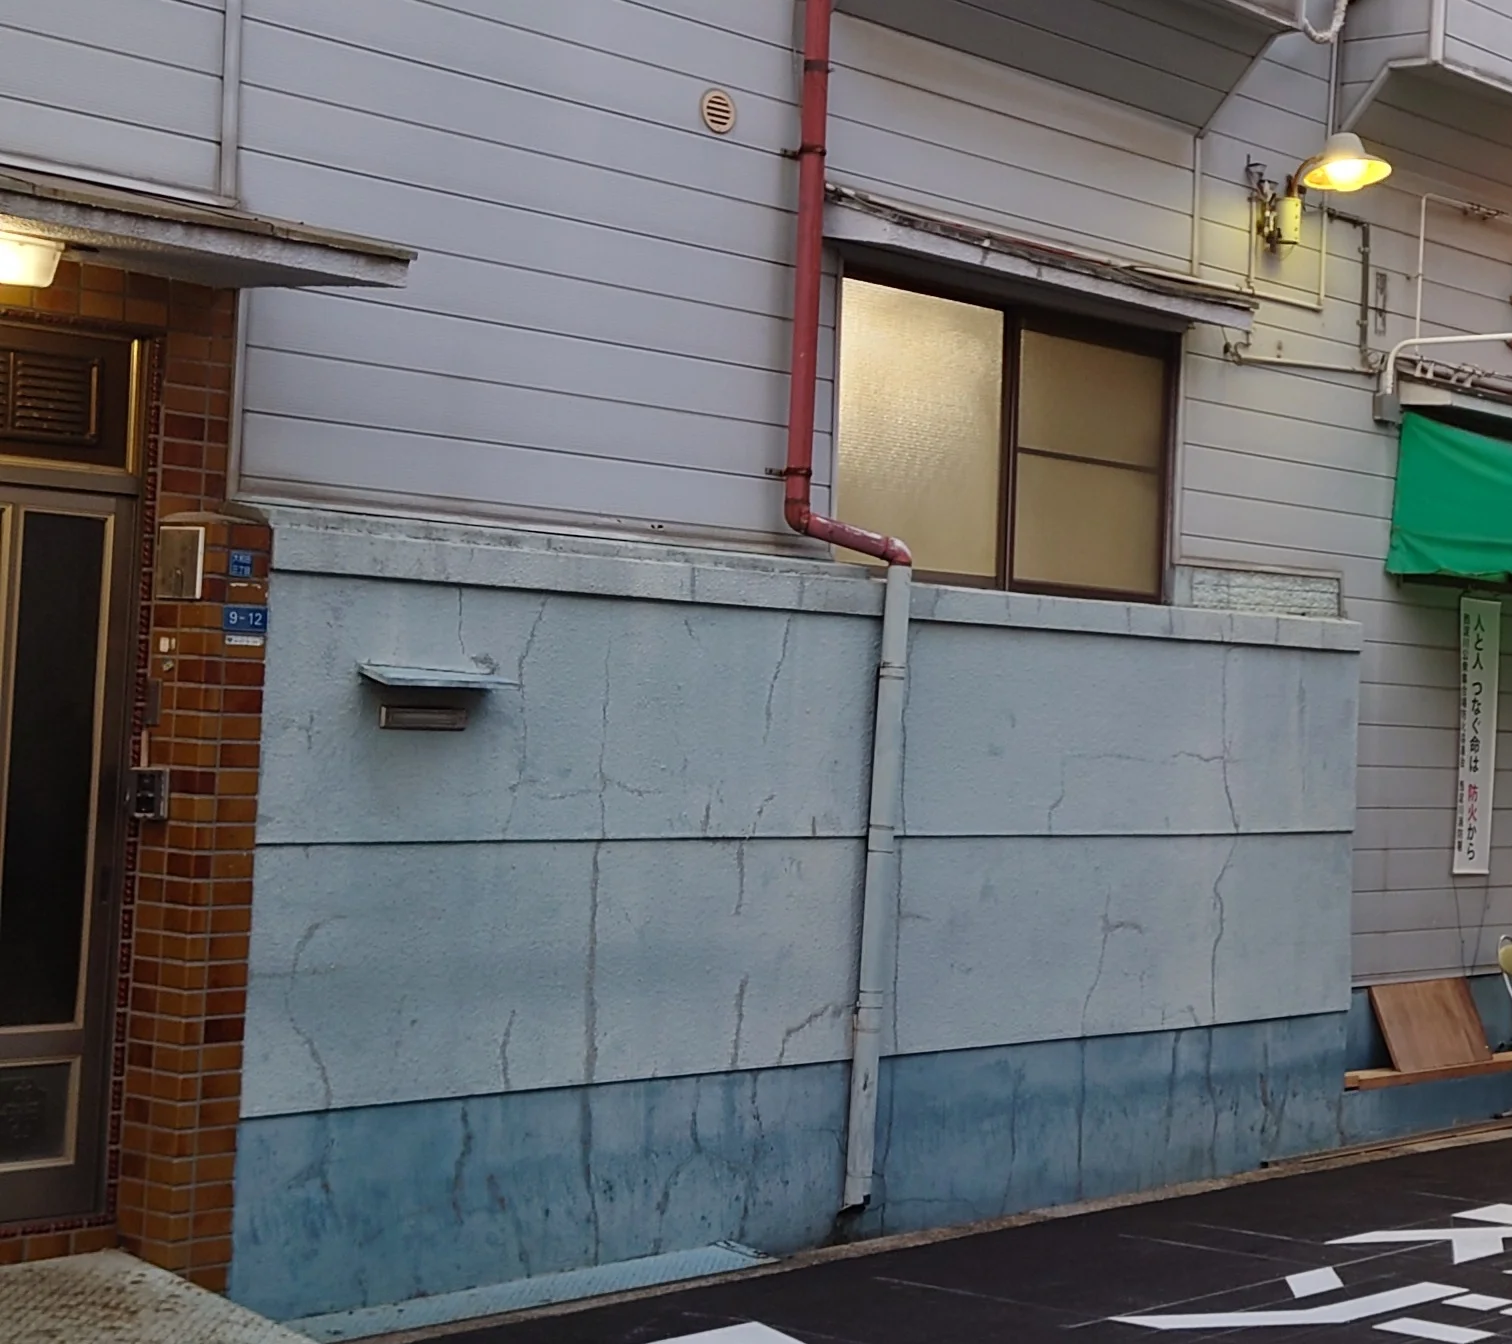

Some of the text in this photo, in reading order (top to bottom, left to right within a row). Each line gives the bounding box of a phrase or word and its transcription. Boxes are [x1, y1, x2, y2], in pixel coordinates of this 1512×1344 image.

[228, 611, 263, 626] 9-12
[1466, 613, 1485, 861] 人と人 つなぐ命は 防火から
